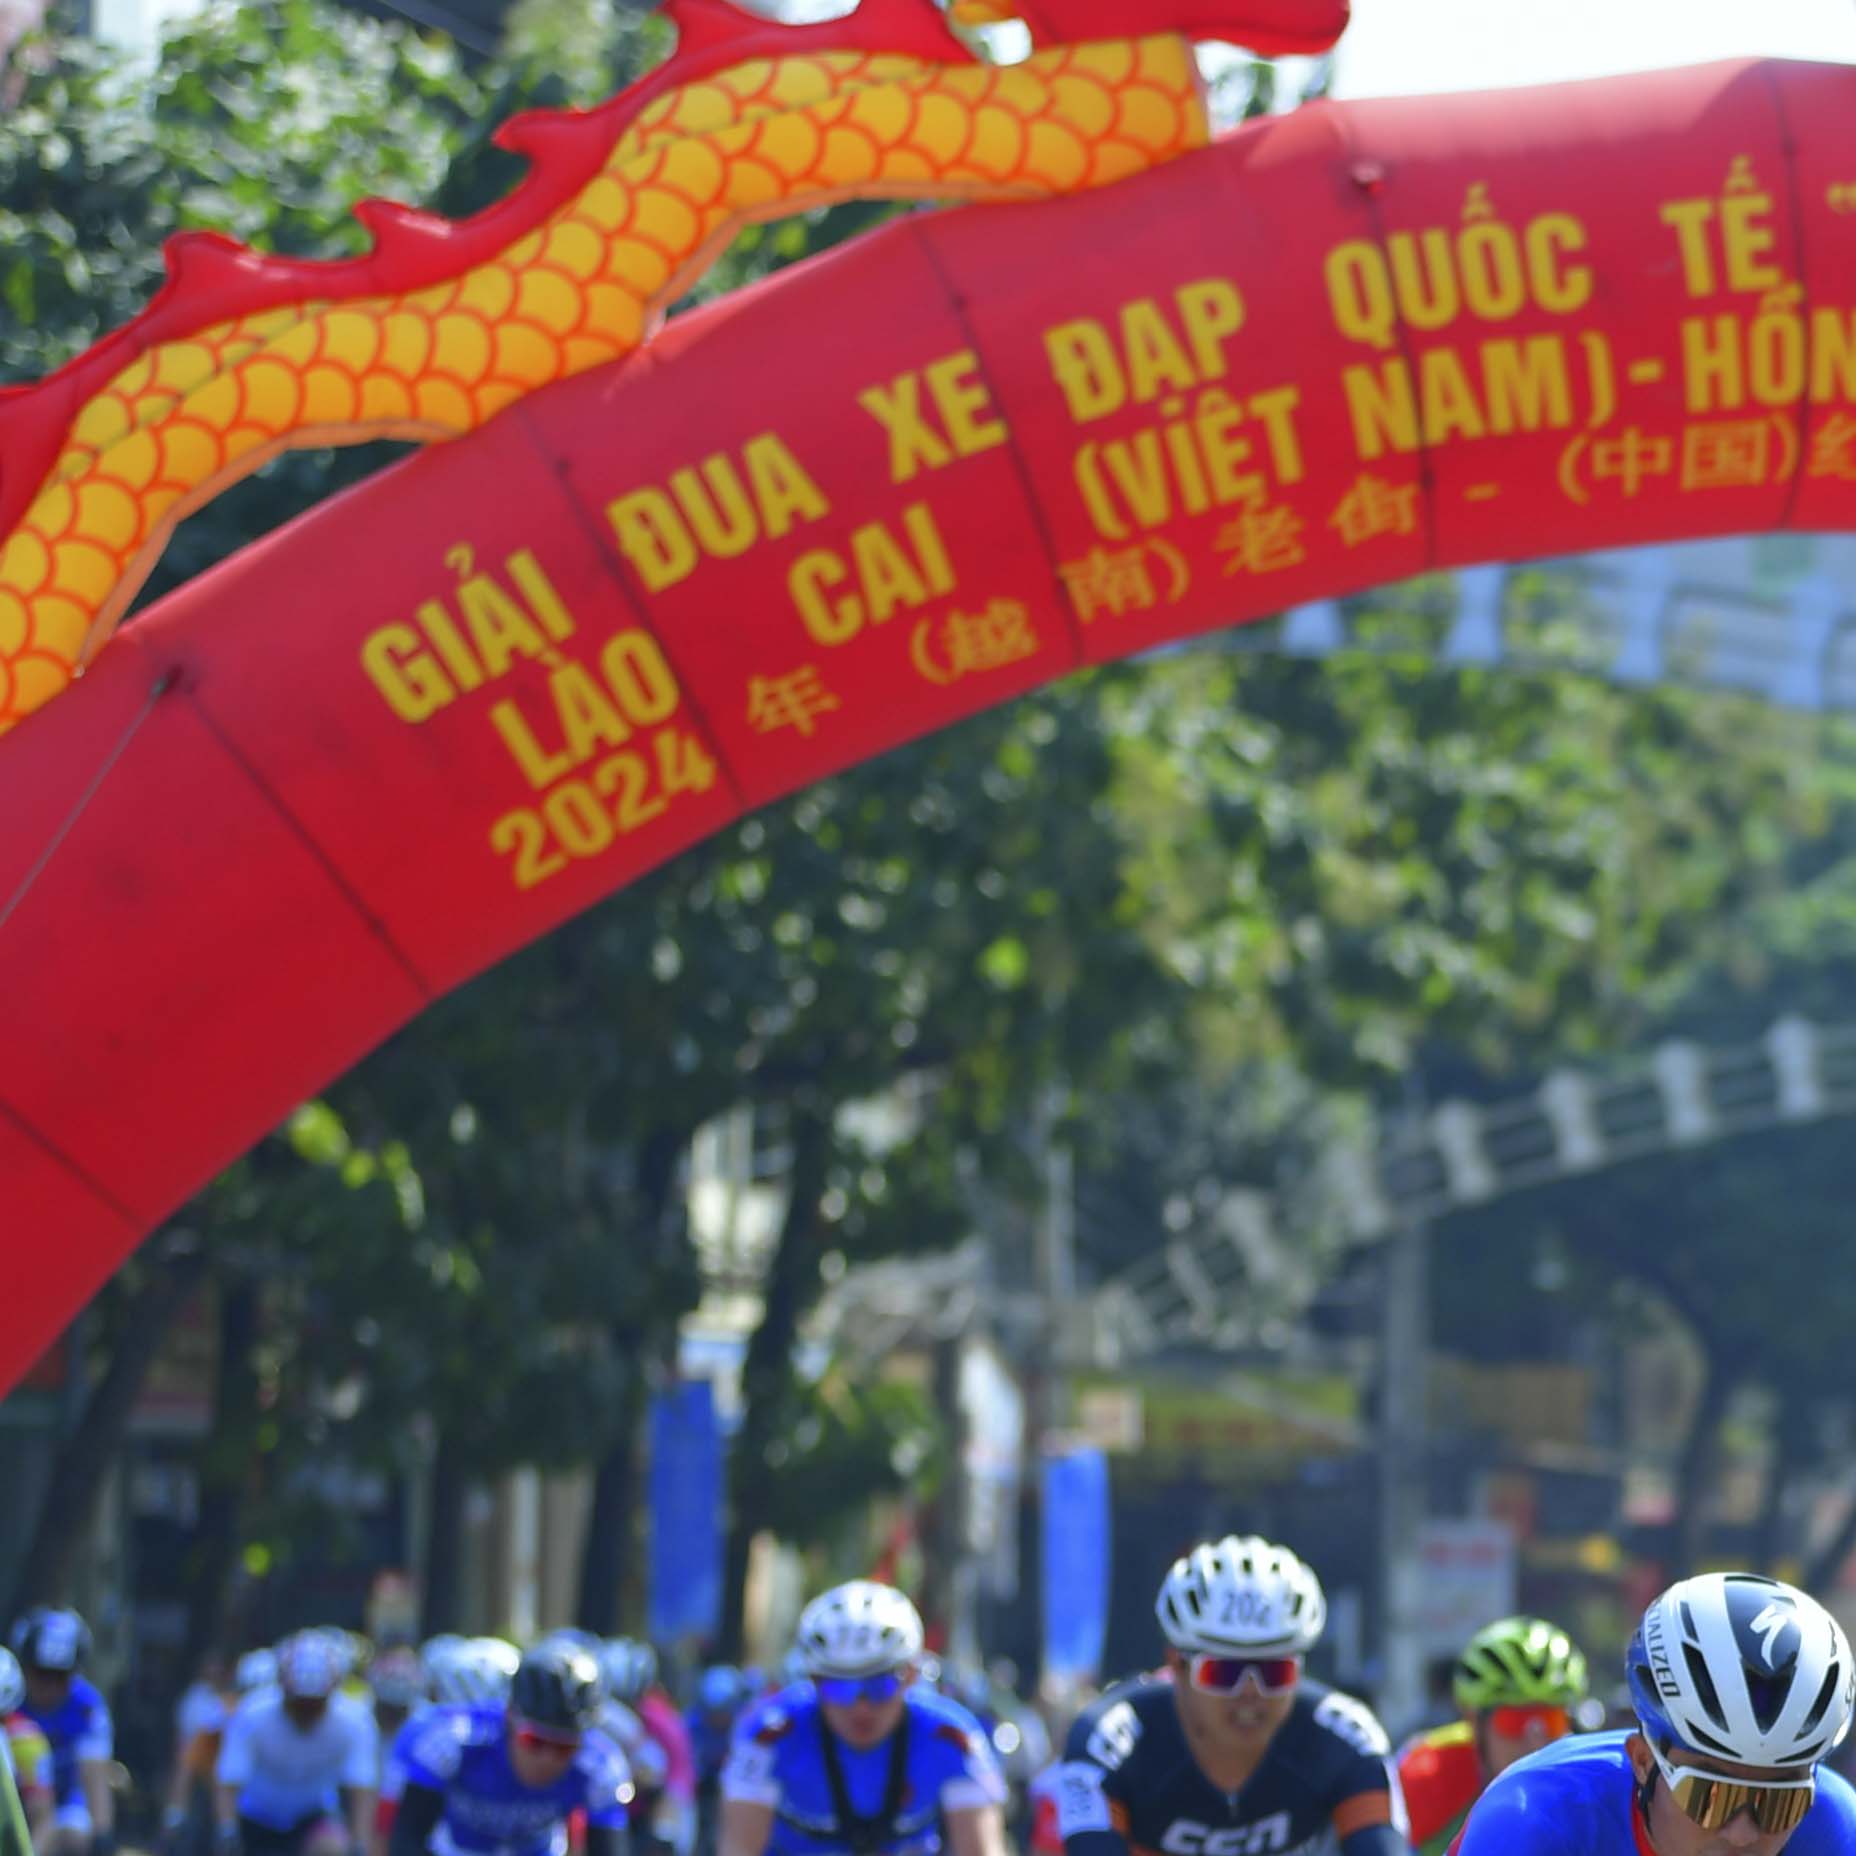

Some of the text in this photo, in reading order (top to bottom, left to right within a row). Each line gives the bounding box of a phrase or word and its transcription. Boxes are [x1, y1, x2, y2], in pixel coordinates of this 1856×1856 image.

[361, 544, 577, 723] GIẢI
[608, 433, 829, 592] ĐUA
[858, 352, 1007, 487] XE
[1325, 183, 1592, 345] QUỐC
[1662, 155, 1781, 298] TẾ
[789, 504, 958, 648] CAI
